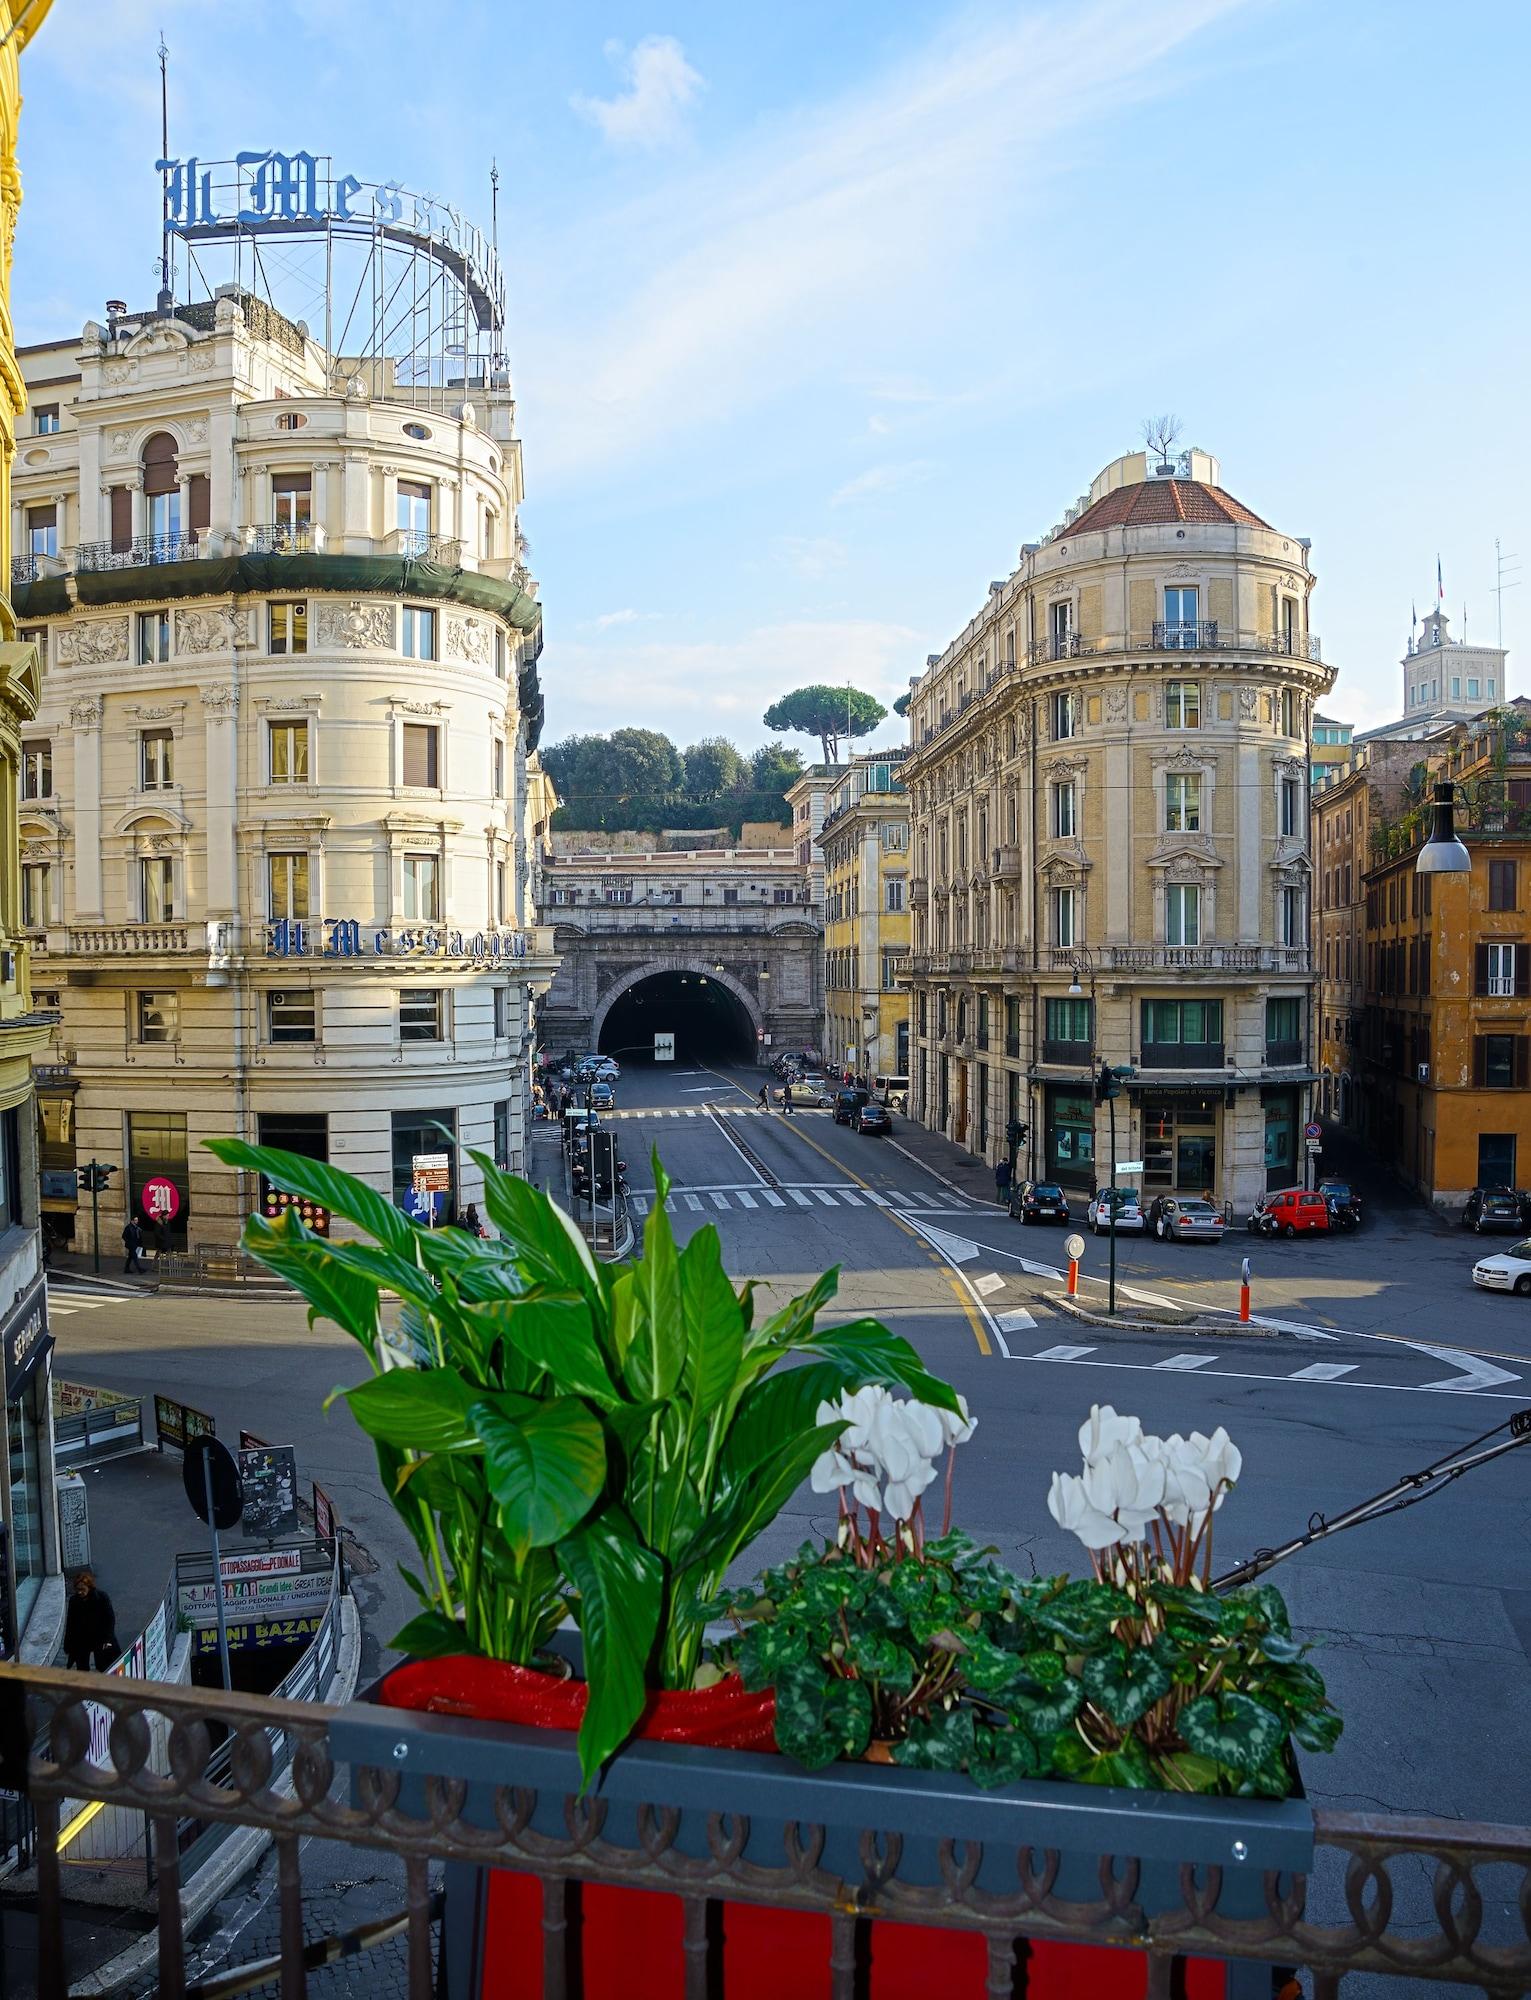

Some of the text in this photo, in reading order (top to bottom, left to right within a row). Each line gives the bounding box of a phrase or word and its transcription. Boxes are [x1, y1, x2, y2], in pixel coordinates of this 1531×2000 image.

[267, 918, 306, 958] Il
[1163, 1088, 1190, 1096] Popolare
[1198, 1088, 1222, 1096] Vicenza
[219, 1554, 300, 1576] OTTOPASSAGGIO PEDONALE
[203, 1586, 218, 1601] Min
[259, 1582, 279, 1595] Grandi
[294, 1578, 315, 1590] GREAT
[183, 1599, 246, 1611] SOTTOPAAGGIO
[249, 1595, 286, 1605] PEDONALE
[201, 1626, 248, 1645] MNI
